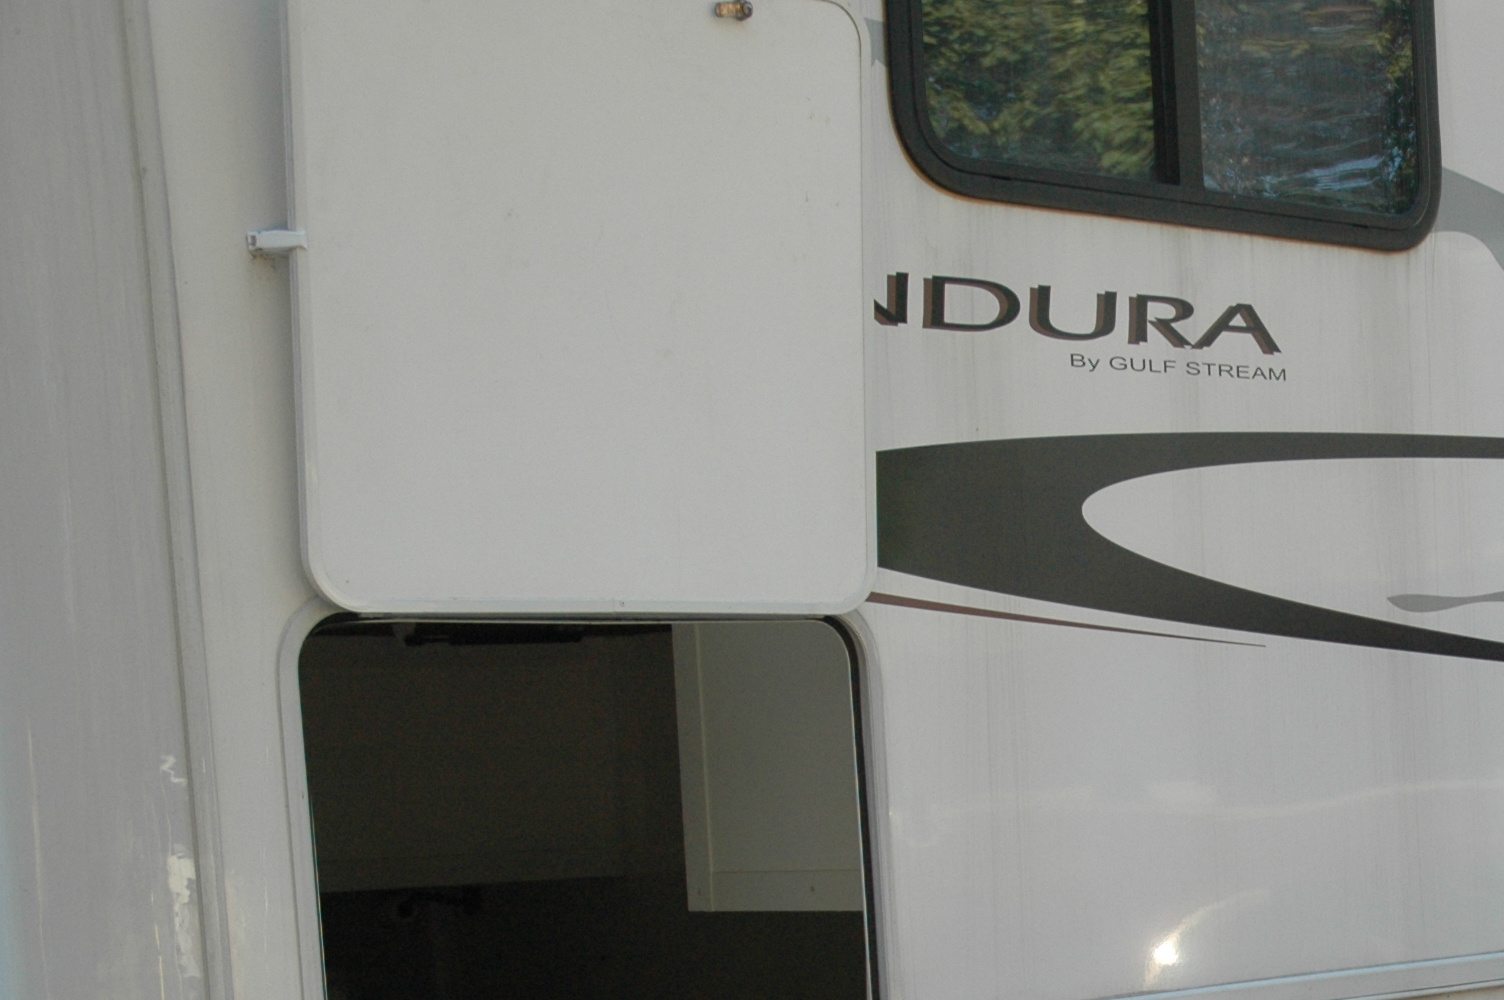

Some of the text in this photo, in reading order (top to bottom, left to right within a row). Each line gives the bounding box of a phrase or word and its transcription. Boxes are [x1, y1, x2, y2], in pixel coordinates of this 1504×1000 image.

[1070, 353, 1287, 381] By GULF STREAM
